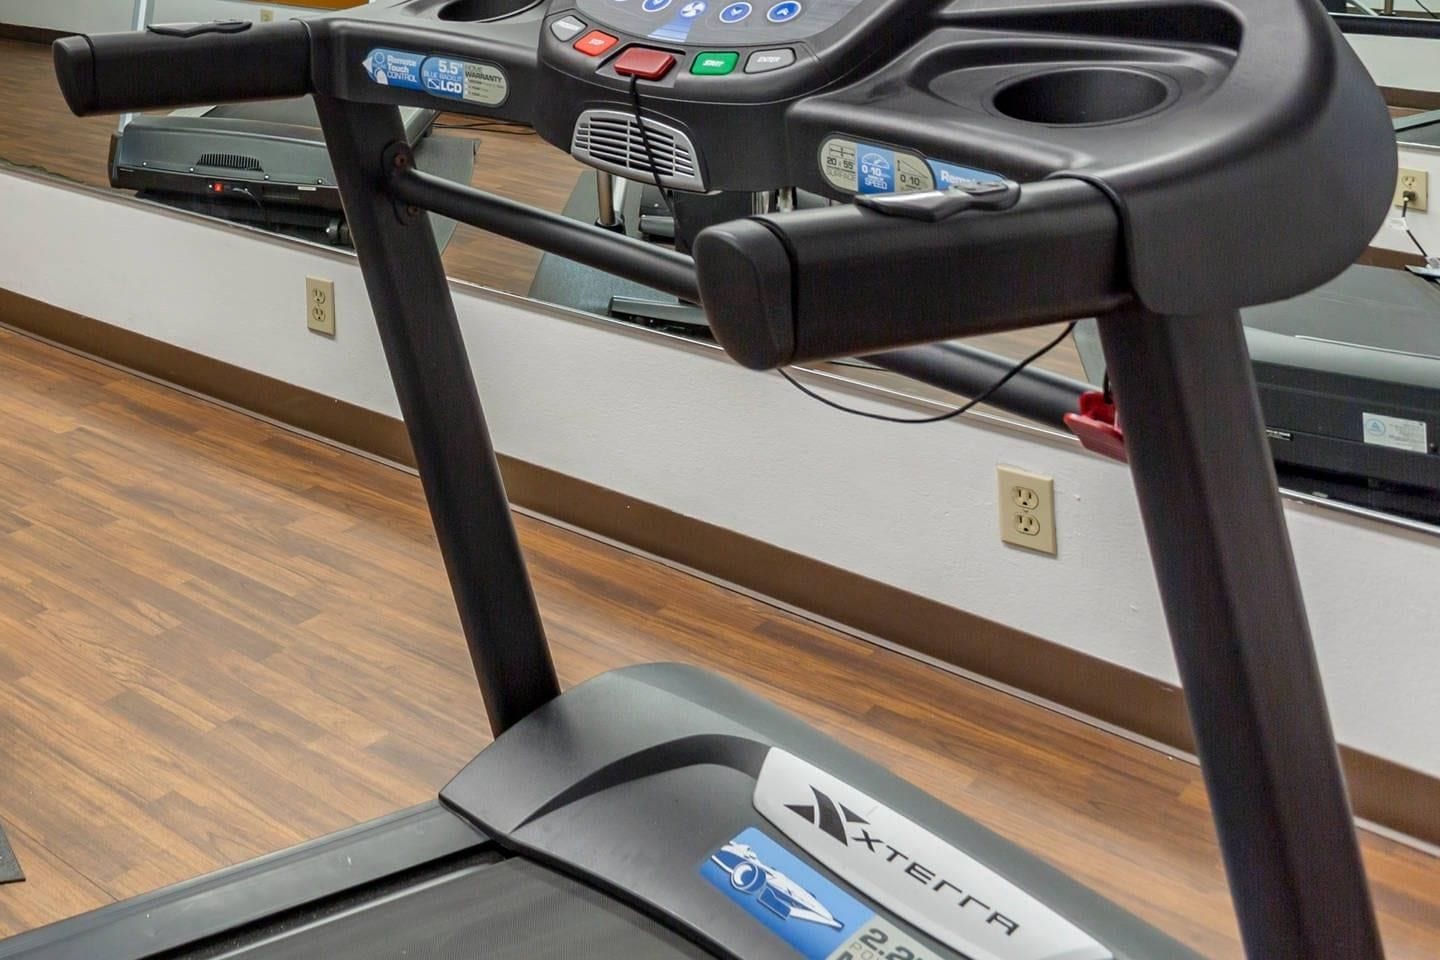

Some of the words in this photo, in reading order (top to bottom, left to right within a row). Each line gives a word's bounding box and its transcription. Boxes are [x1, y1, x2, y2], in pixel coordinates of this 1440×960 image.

[387, 71, 417, 83] CONTROL
[465, 70, 503, 83] WARRANTY
[440, 80, 462, 94] LCD
[864, 176, 888, 190] SPEED
[851, 830, 1021, 936] XTERRA
